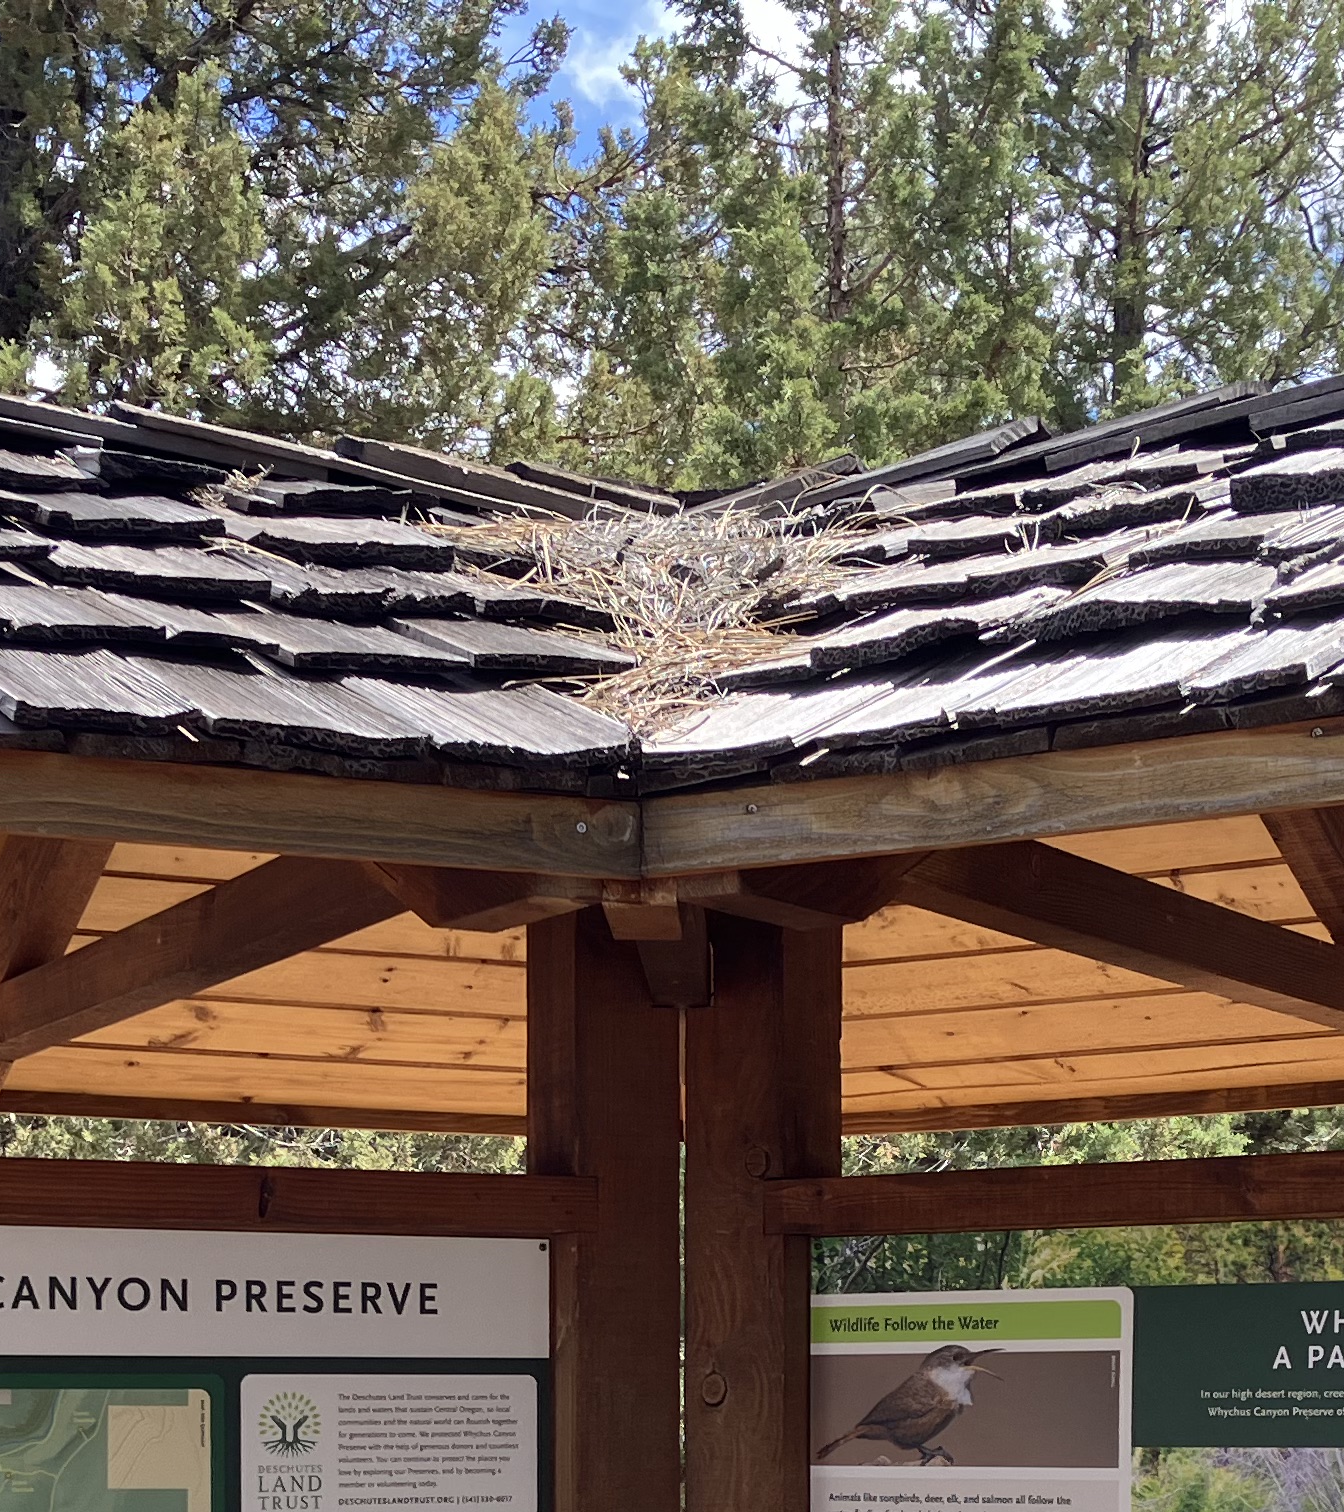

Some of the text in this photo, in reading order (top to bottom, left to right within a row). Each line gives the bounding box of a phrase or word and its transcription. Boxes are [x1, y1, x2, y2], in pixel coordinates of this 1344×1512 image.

[215, 1279, 439, 1316] PRESERVE
[829, 1316, 1000, 1332] Wildlife Follow the Water
[1272, 1345, 1292, 1370] A
[257, 1464, 323, 1474] DESCHUTES
[257, 1475, 323, 1493] LAND
[257, 1496, 323, 1510] TRUST
